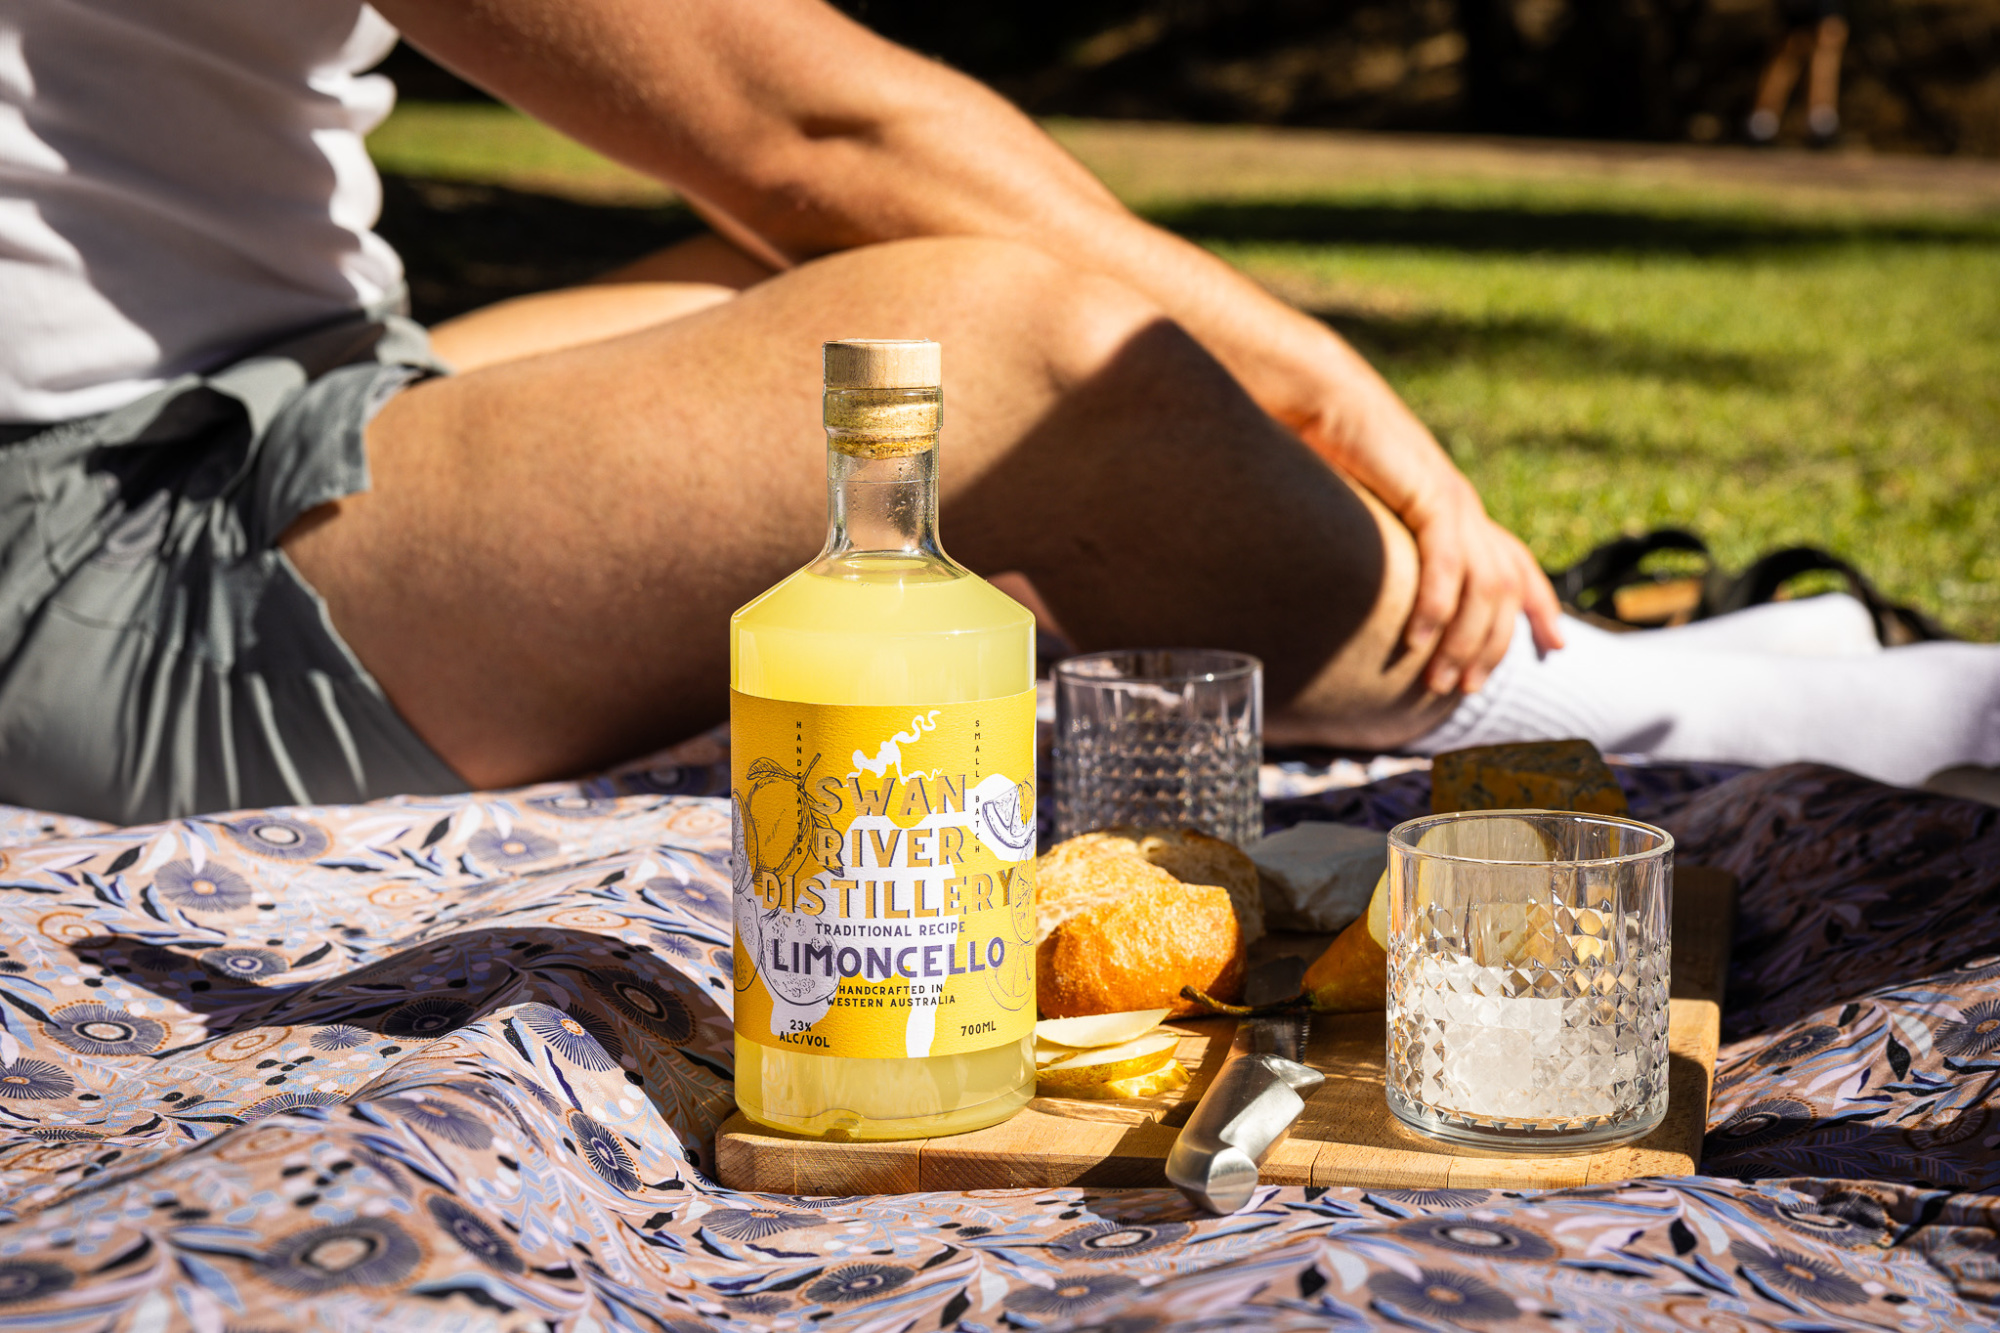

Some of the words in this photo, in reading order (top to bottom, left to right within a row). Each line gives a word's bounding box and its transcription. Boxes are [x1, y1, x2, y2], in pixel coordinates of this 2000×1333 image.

[815, 774, 966, 817] SWAN
[817, 826, 964, 869] RIVER
[761, 866, 1017, 919] DISTILLERY
[815, 923, 912, 938] TRADITIONAL
[919, 921, 966, 937] RECIPE
[771, 936, 1006, 979] LIMONCELLO
[838, 984, 925, 996] HANDCRAFTED
[931, 983, 943, 994] IN
[826, 996, 883, 1008] WESTERN
[890, 995, 956, 1008] AUSTRALIA
[789, 1019, 812, 1033] 23%
[960, 1021, 997, 1037] 700ML
[779, 1031, 830, 1048] ALC/VOL
